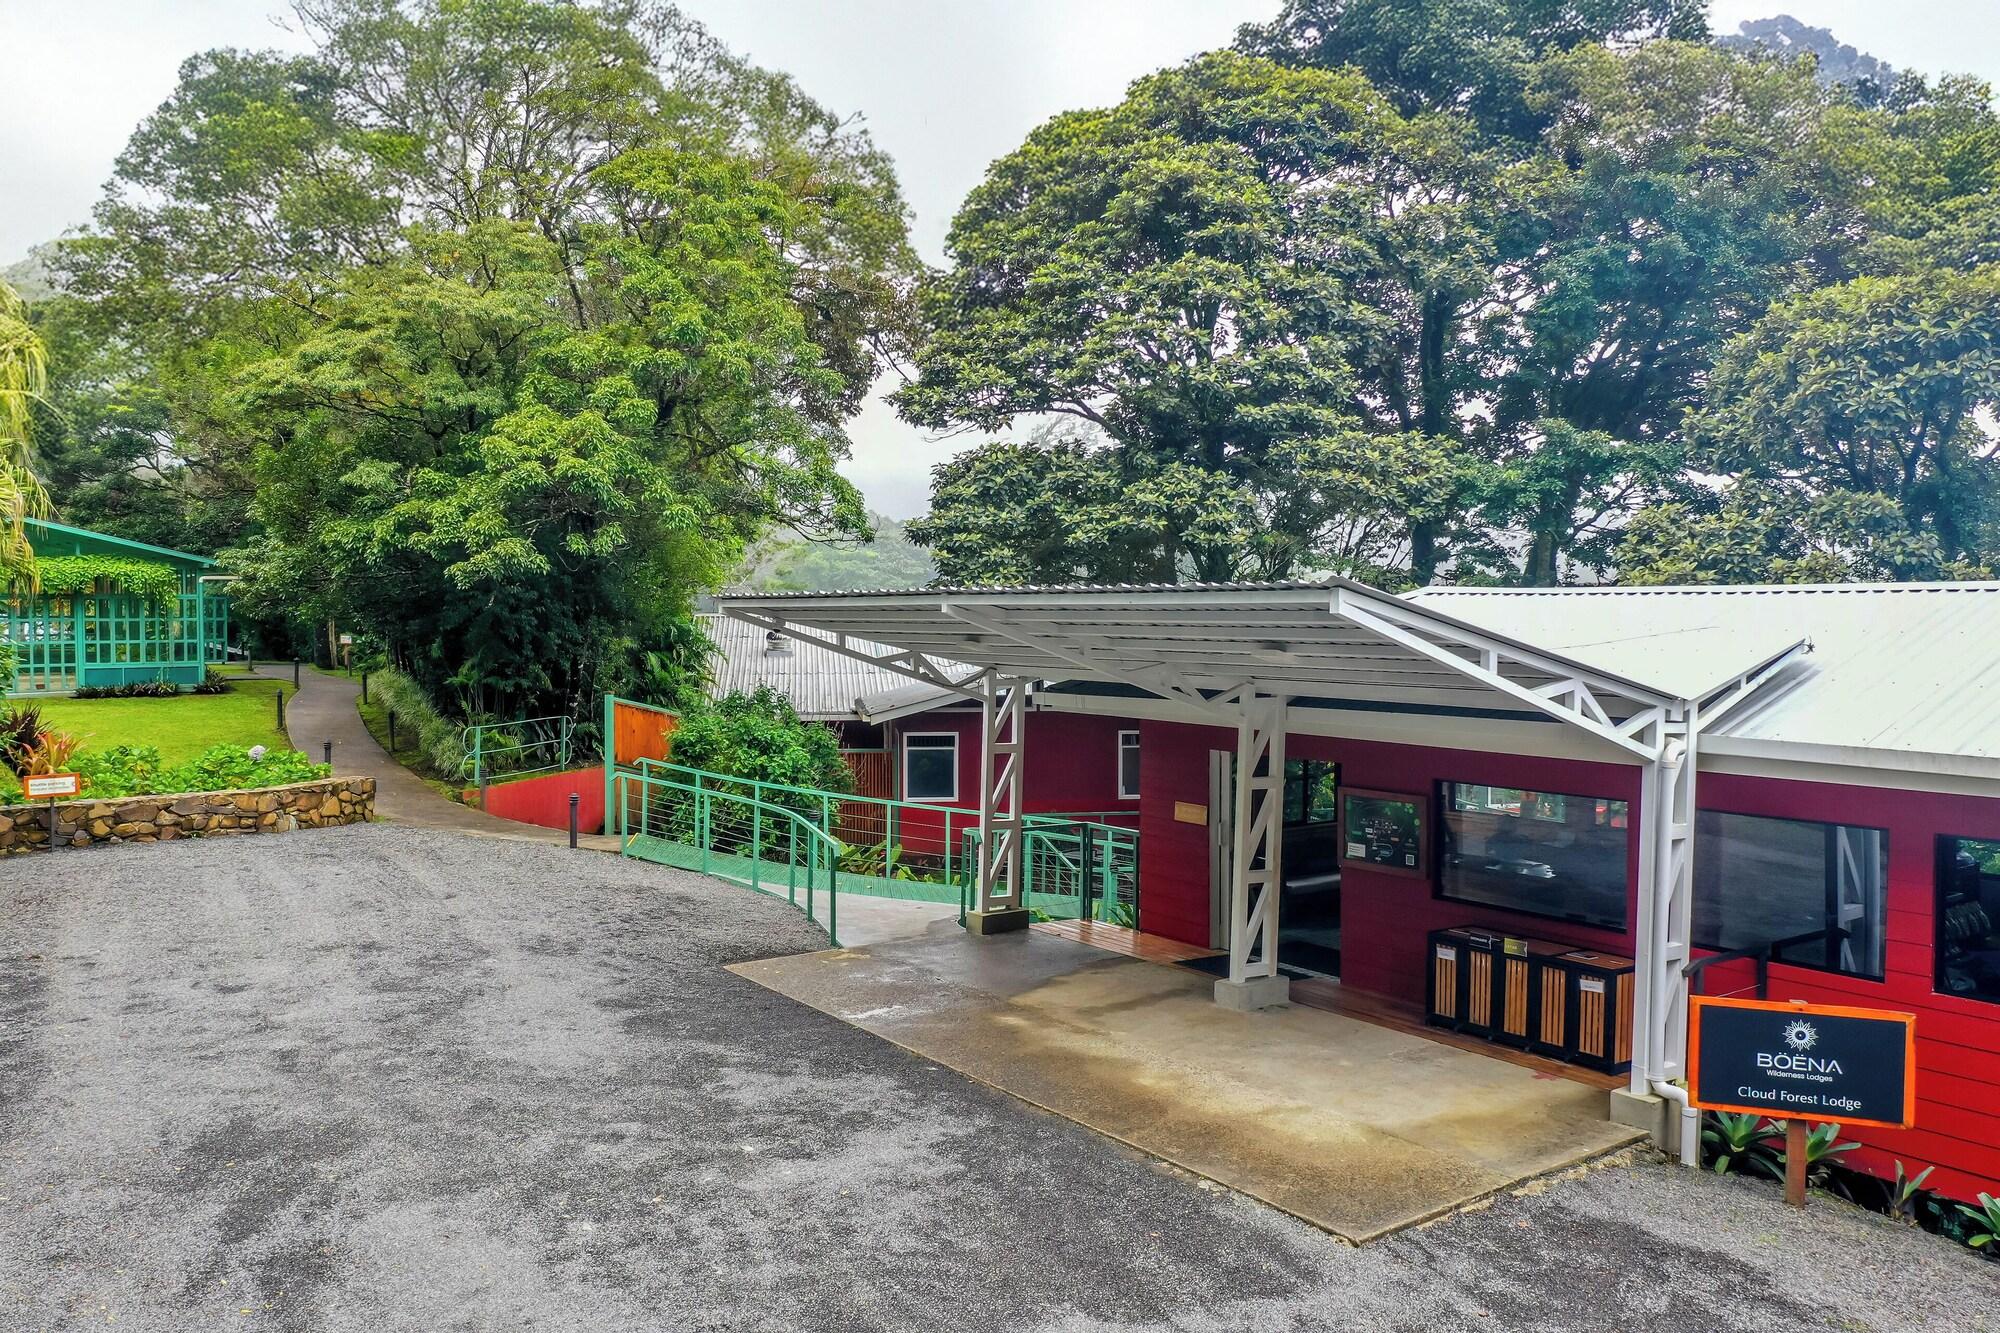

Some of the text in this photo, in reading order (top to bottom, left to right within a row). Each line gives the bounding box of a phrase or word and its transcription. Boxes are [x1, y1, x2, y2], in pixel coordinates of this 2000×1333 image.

[1757, 1052, 1843, 1074] BÖËNA
[1766, 1069, 1833, 1083] Wilderness Lodges
[1738, 1086, 1862, 1111] Cloud Forest Lodge
